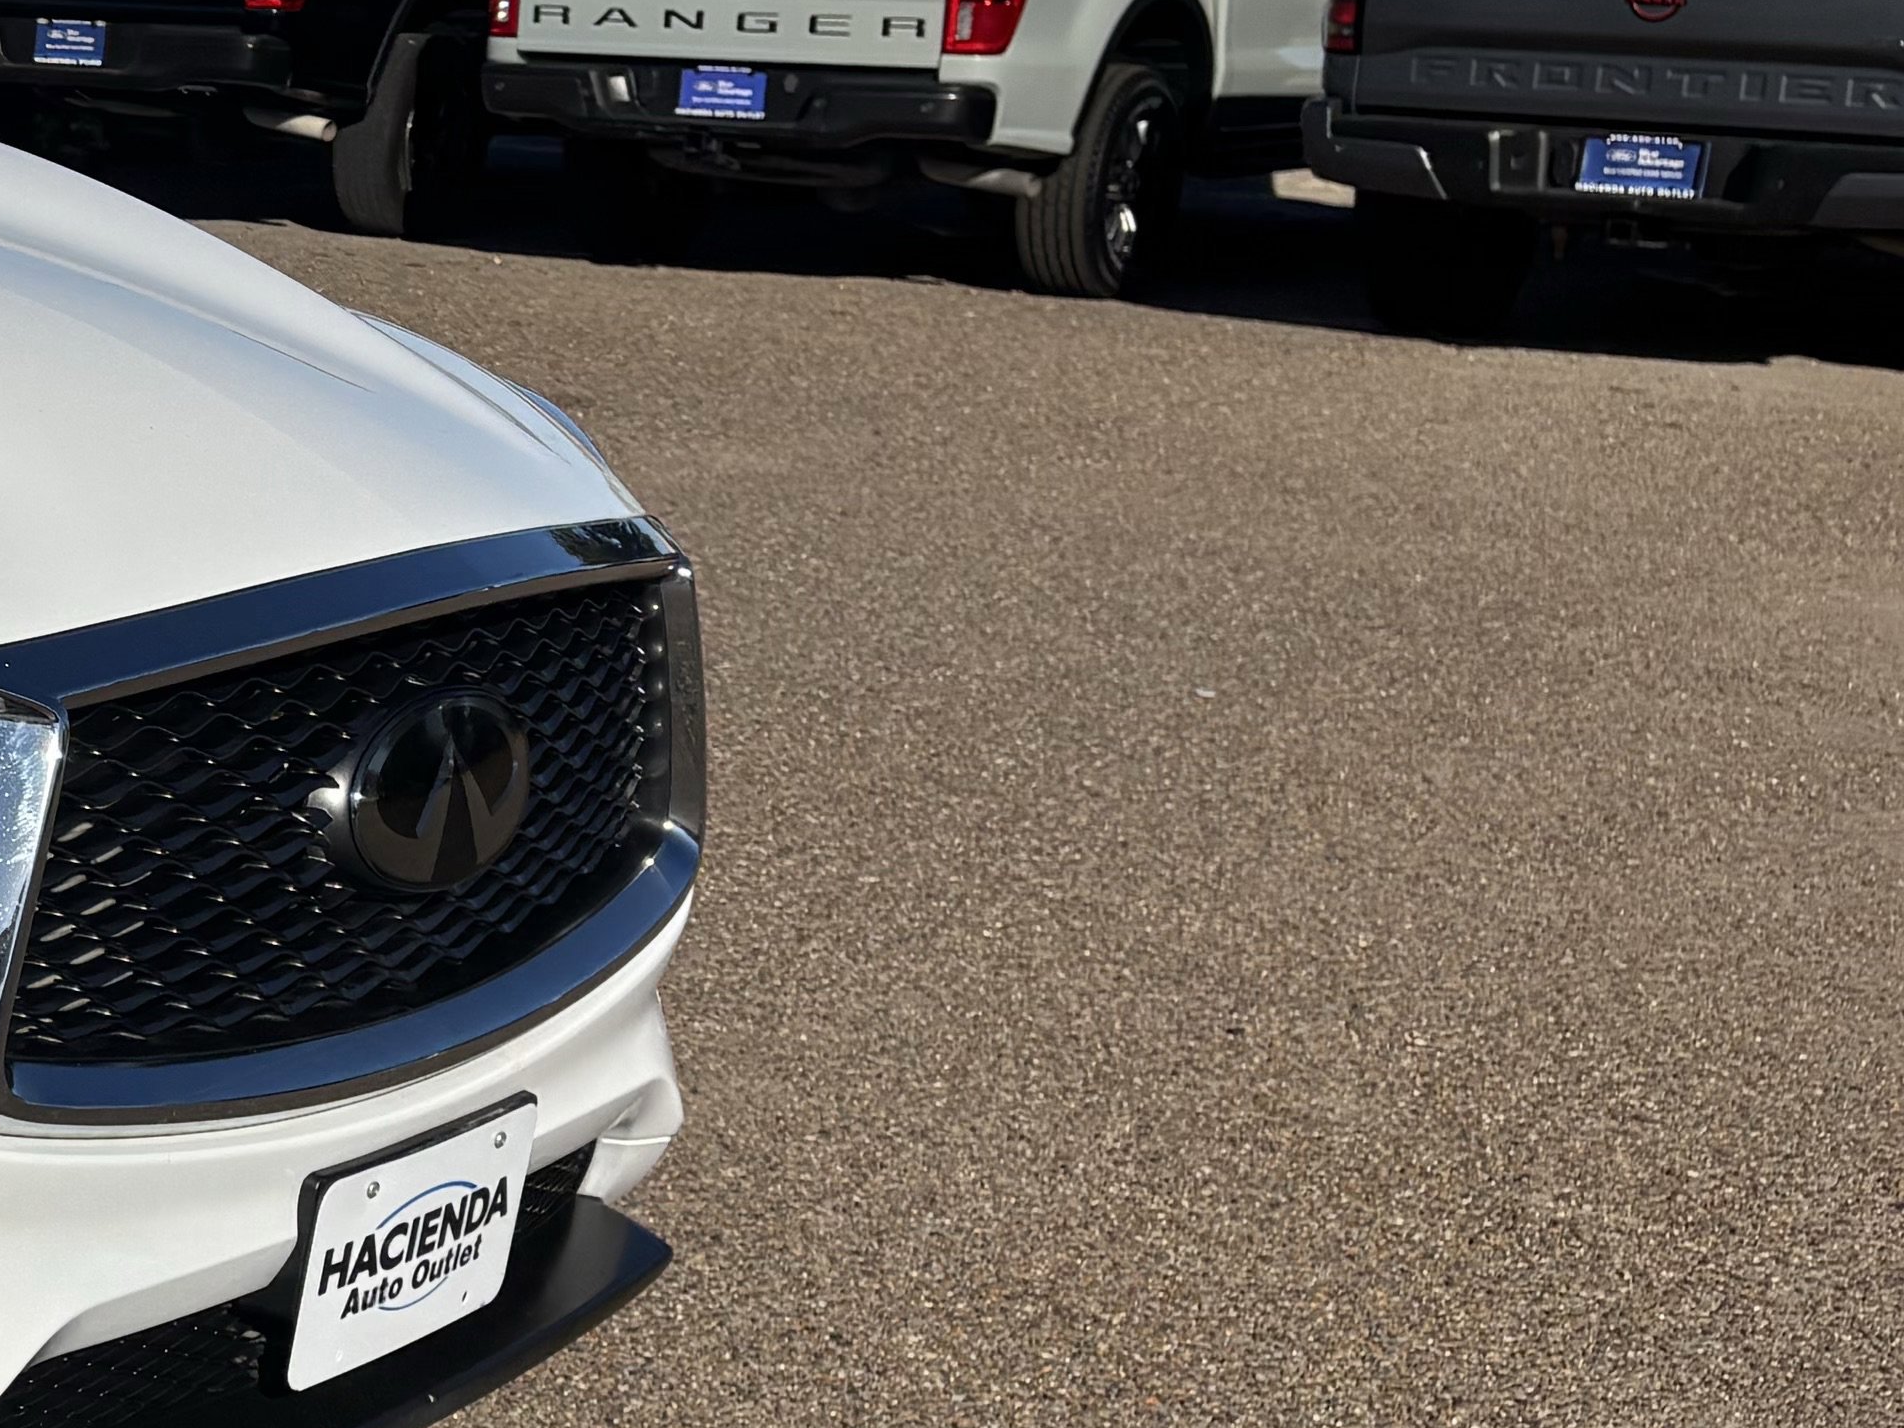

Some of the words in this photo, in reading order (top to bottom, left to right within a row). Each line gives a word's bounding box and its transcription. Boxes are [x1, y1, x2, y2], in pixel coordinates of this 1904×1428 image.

[533, 5, 925, 38] RANGER
[1410, 56, 1904, 110] FRONTIER
[318, 1176, 508, 1296] HACIENDA
[341, 1277, 403, 1320] Auto
[411, 1233, 482, 1289] Outlet
